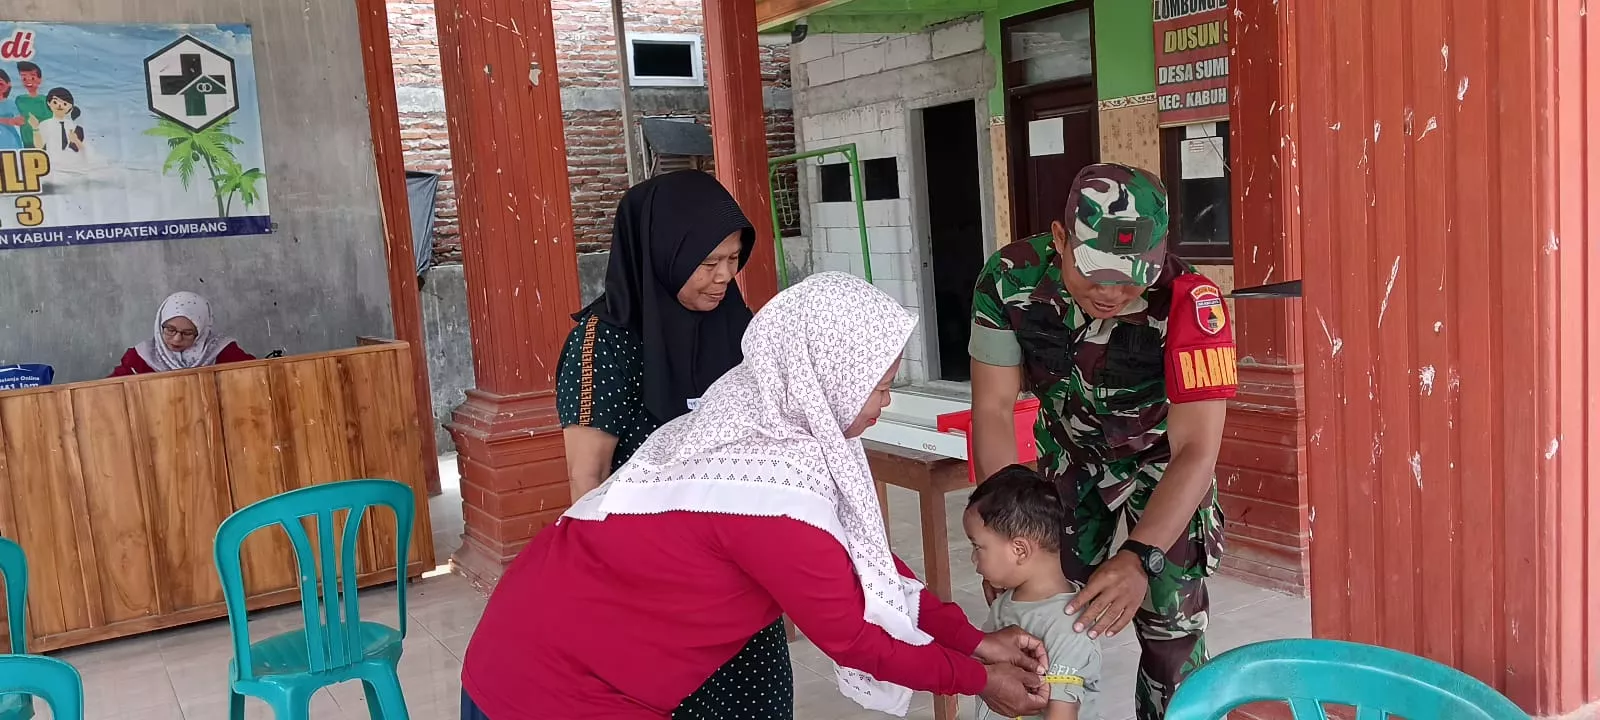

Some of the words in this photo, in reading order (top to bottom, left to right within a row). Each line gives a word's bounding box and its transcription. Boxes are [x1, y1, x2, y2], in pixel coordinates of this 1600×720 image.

[2, 31, 33, 59] di
[1164, 21, 1220, 53] DUSUN
[1158, 63, 1194, 85] DESA
[1158, 94, 1184, 111] KEC.
[1186, 87, 1227, 108] KABUH
[0, 149, 50, 194] LP
[15, 195, 44, 227] 3
[13, 231, 64, 245] KABUH
[75, 225, 158, 241] KABUPATEN
[161, 221, 228, 236] JOMBANG
